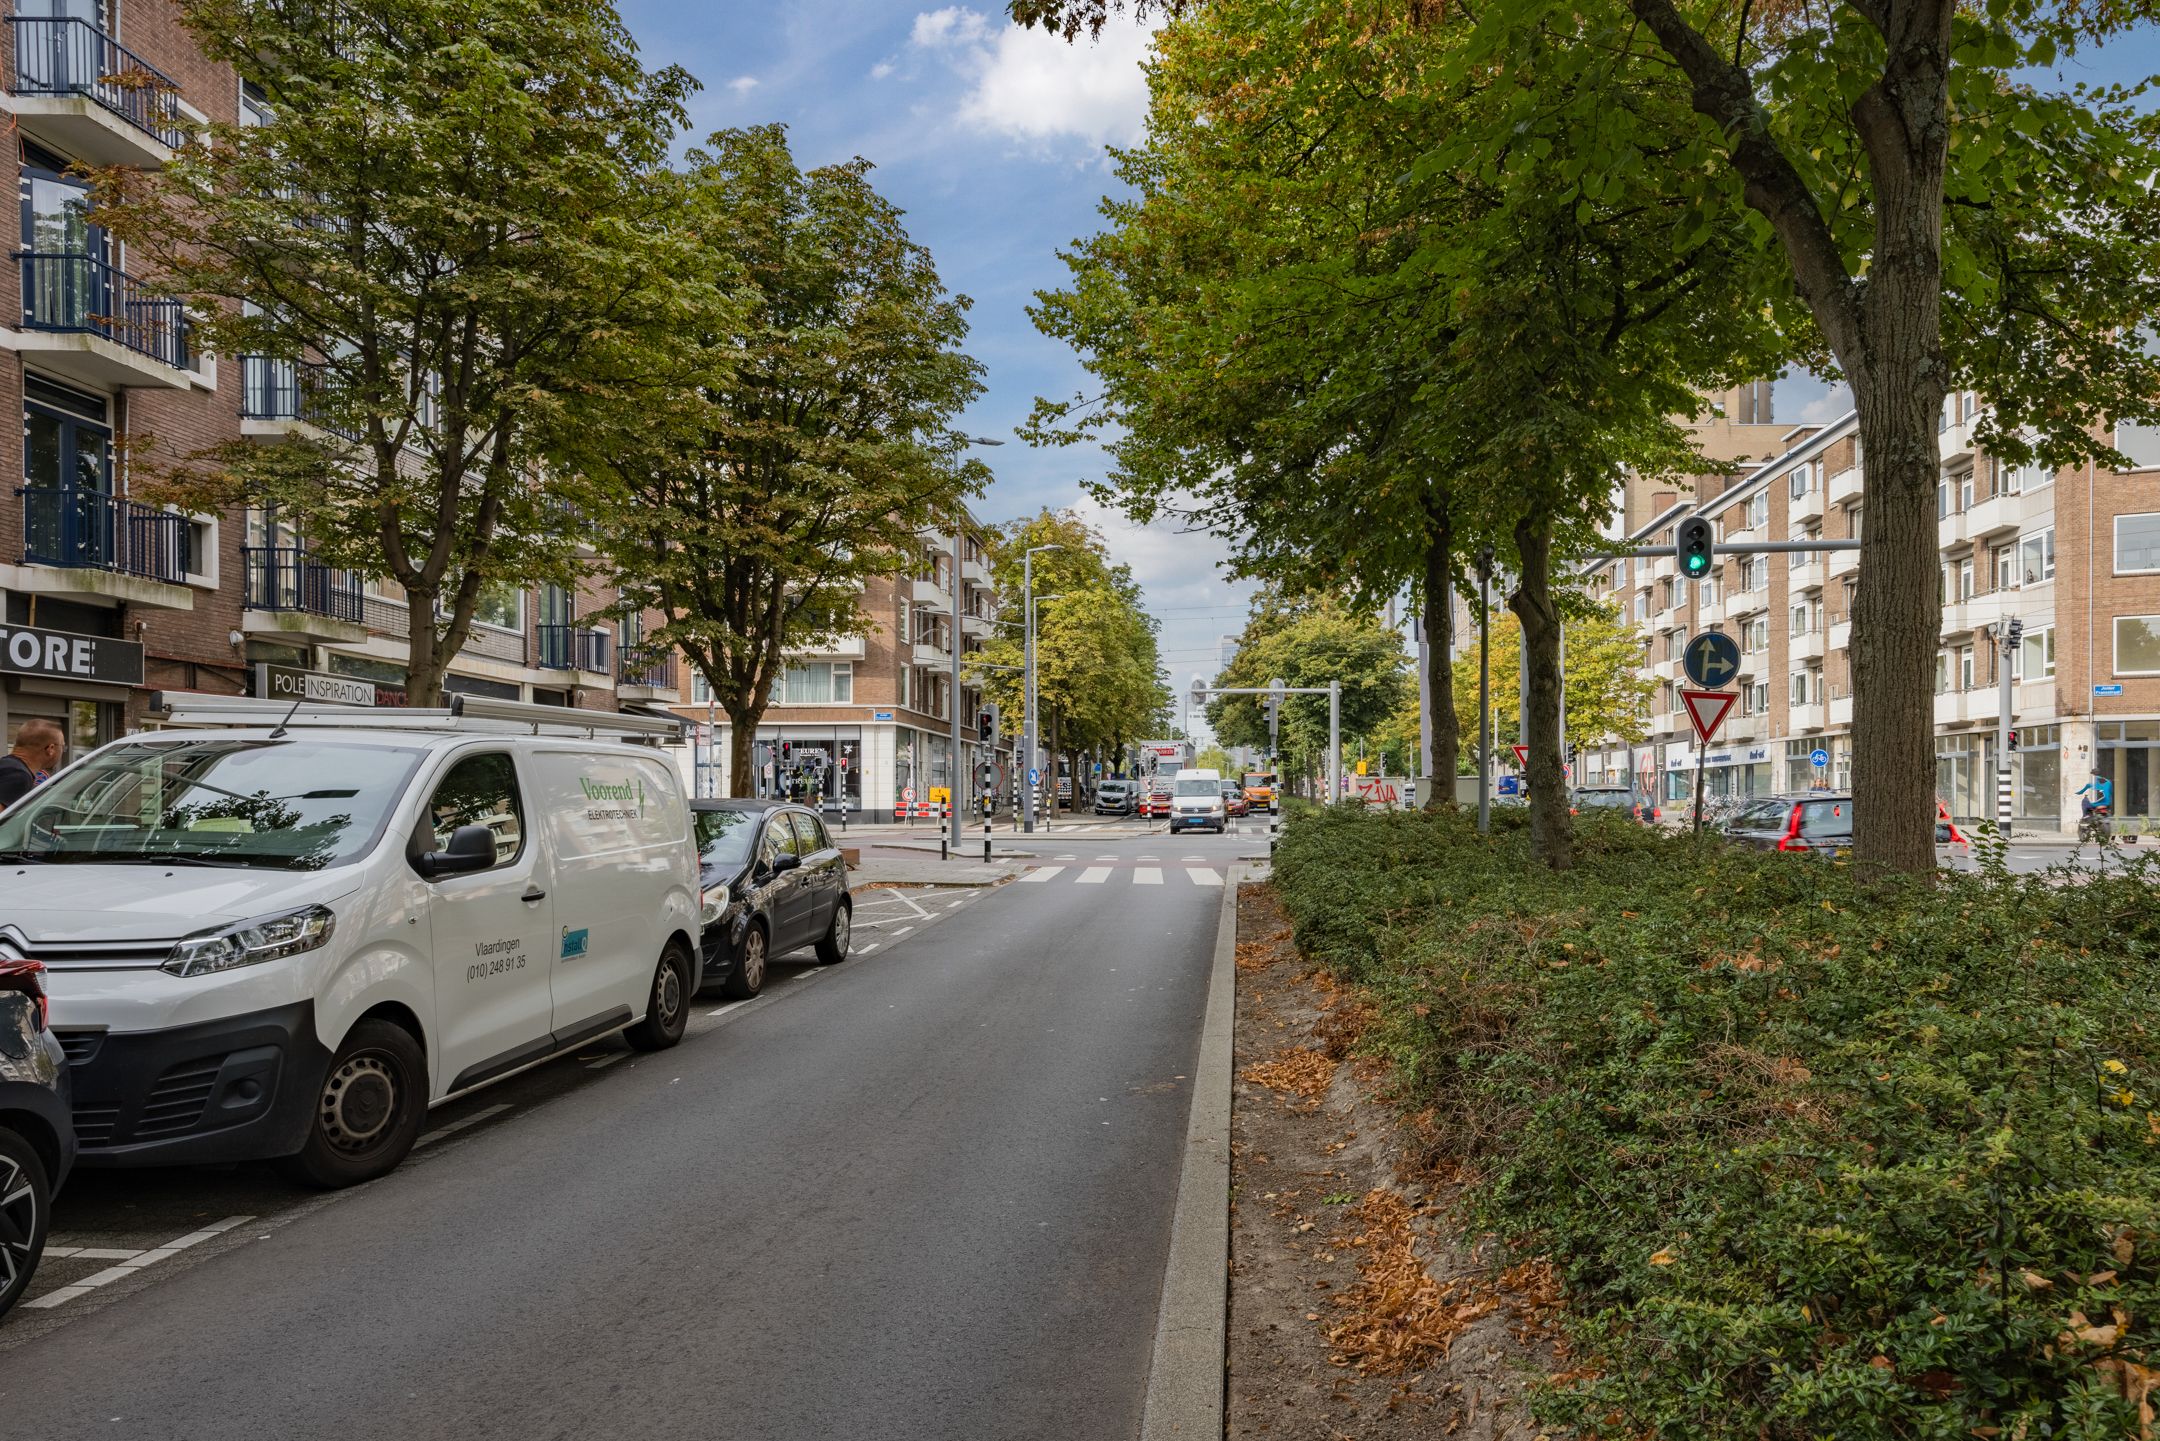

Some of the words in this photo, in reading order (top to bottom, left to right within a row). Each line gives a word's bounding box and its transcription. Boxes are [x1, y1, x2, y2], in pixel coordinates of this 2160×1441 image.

[275, 674, 304, 695] POLE
[307, 679, 372, 703] INSPIRATION
[579, 778, 633, 800] Voorend
[588, 809, 638, 820] ELEKTROTECHNIEK
[475, 939, 520, 956] Vlaardingen
[466, 963, 488, 983] (010)
[489, 960, 504, 975] 248
[505, 958, 515, 972] 91
[517, 954, 527, 969] 35
